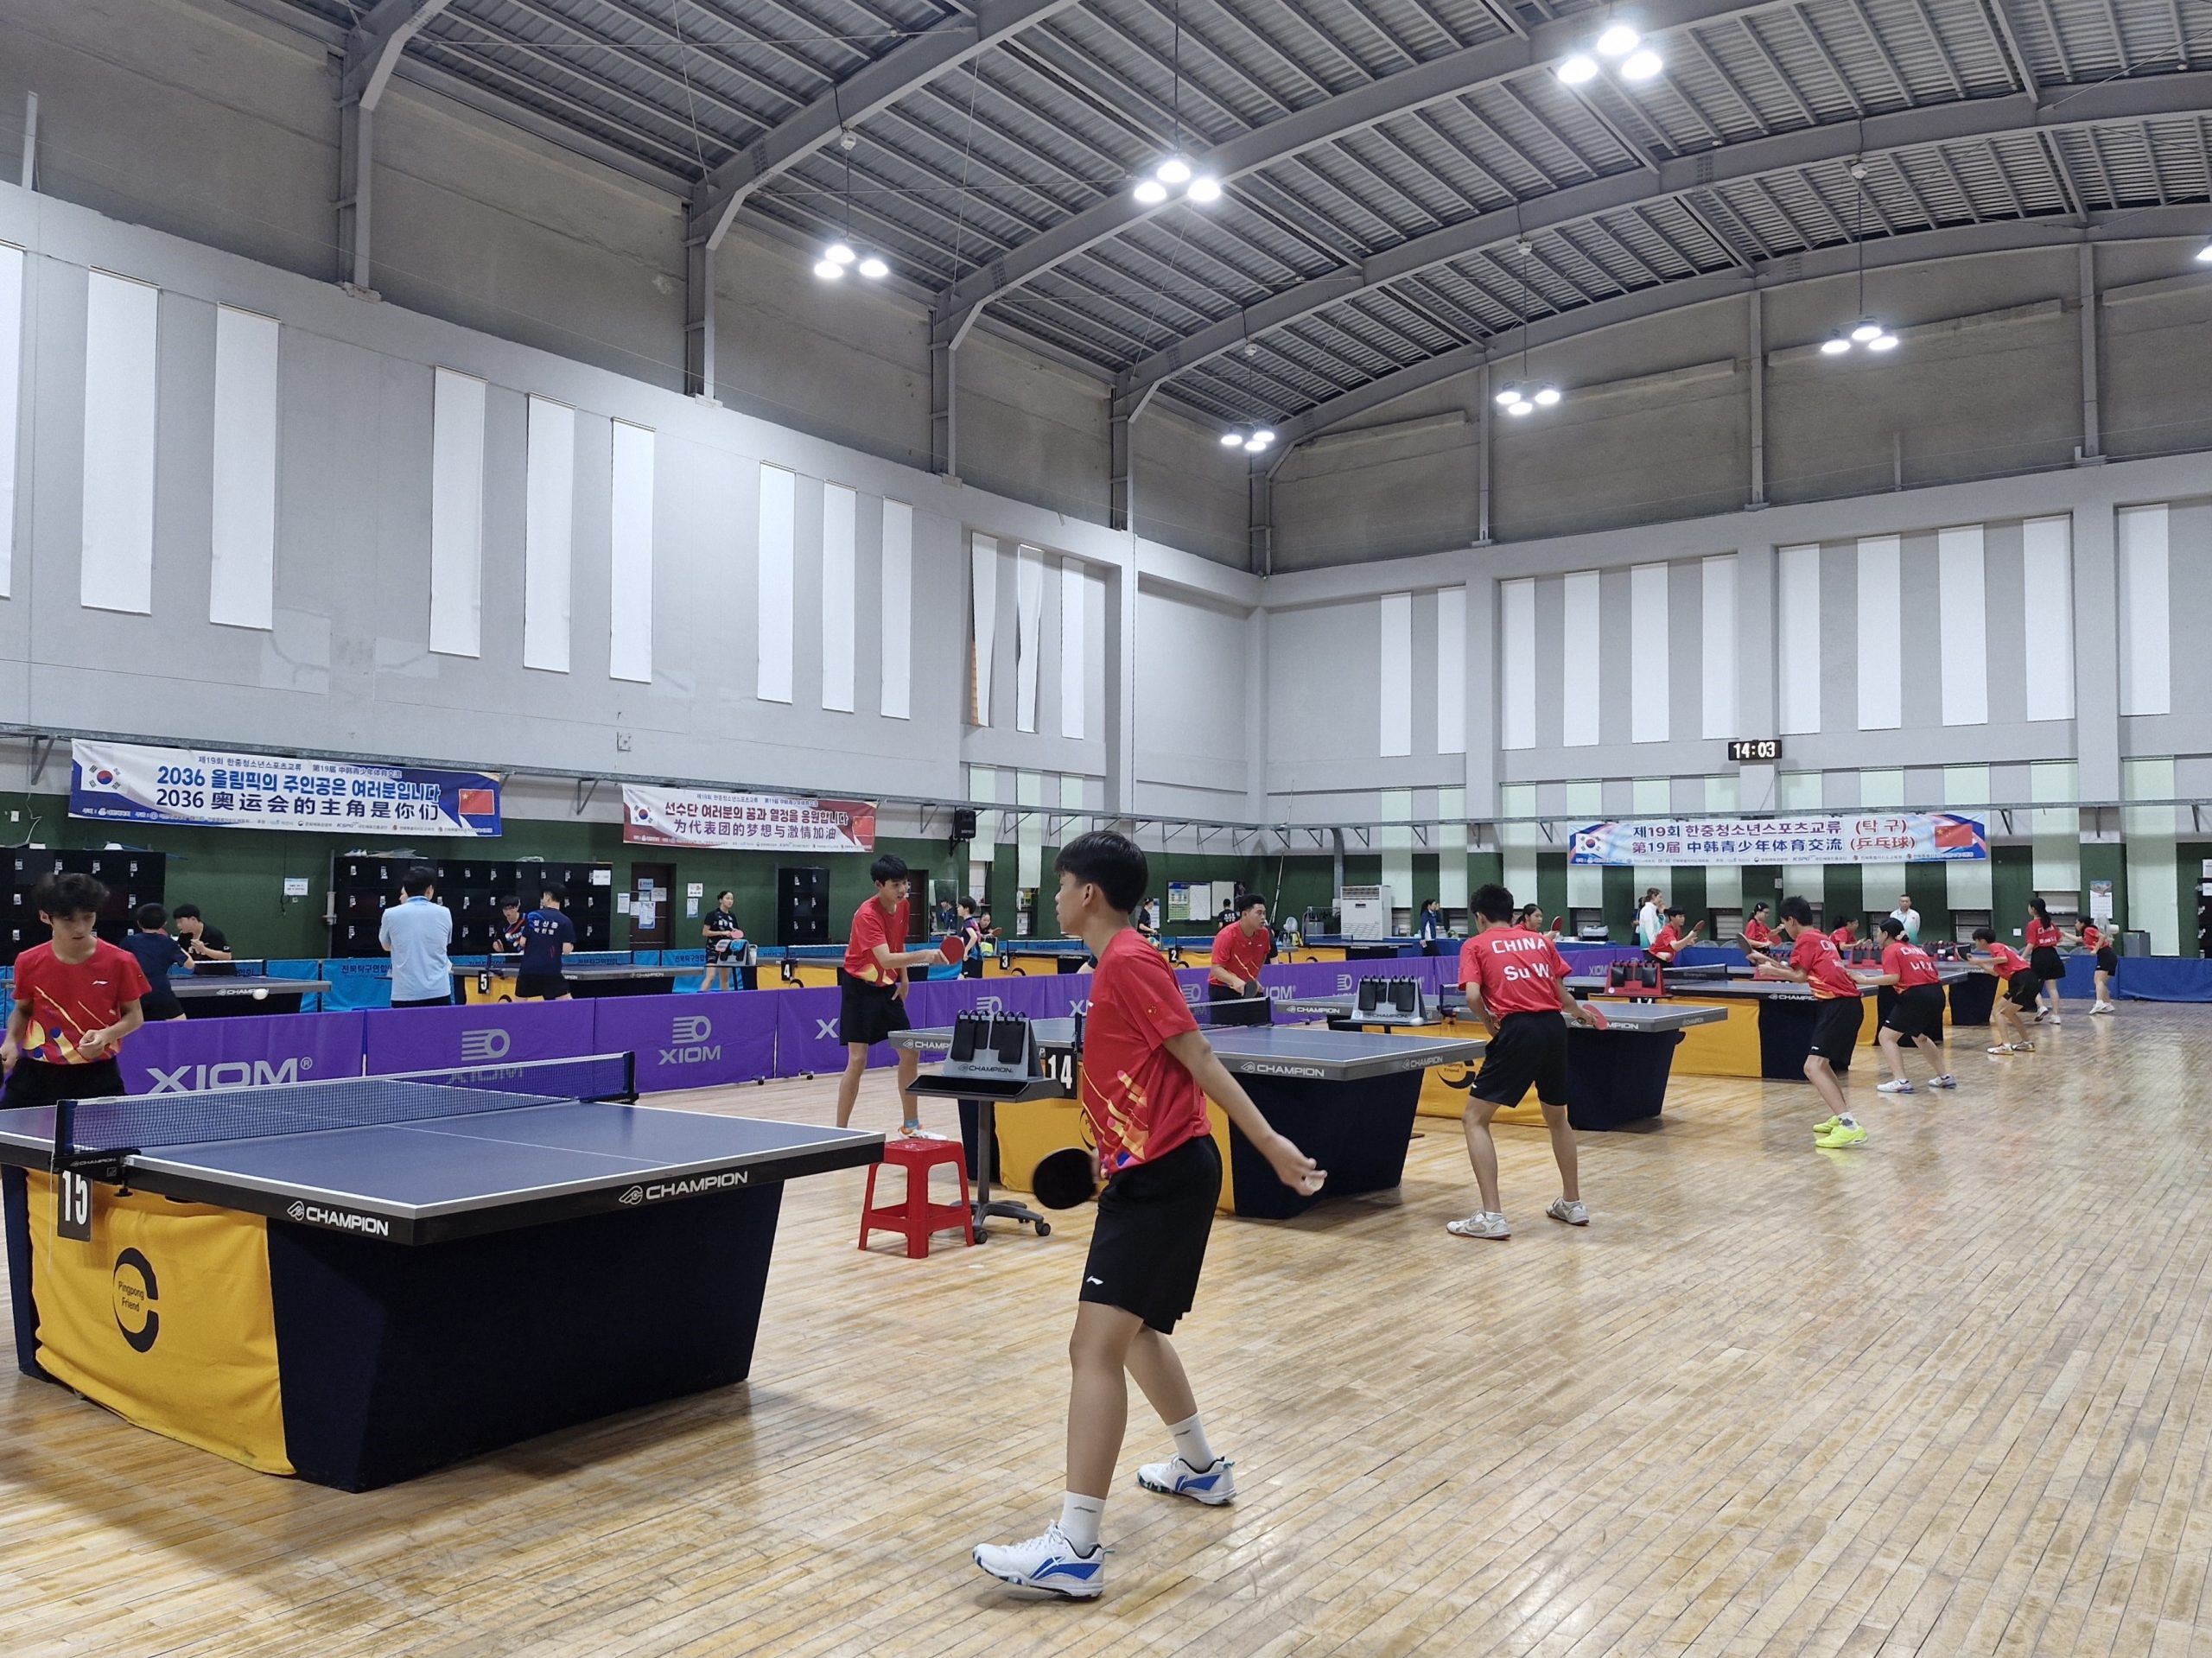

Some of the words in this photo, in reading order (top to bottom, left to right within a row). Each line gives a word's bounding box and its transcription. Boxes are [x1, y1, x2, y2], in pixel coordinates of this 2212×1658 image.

[1733, 741, 1775, 759] 14:03
[157, 765, 206, 787] 2036
[211, 769, 277, 792] 올림픽의
[283, 775, 346, 797] 주인공은
[352, 779, 442, 802] 여러분입니다
[156, 788, 204, 808] 2036
[211, 791, 439, 821] 奥运会的主角是你们
[664, 802, 698, 817] 선수단
[702, 804, 743, 820] 여러분의
[746, 807, 767, 821] 꿈과
[770, 809, 798, 823] 열정을
[801, 810, 848, 825] 응원합니다
[674, 818, 836, 840] 为代表团的梦想与激情加油
[1632, 825, 1681, 838] 제19회
[1685, 821, 1842, 838] 한중청소년스포츠교류
[1632, 842, 1681, 854] 第19届
[1491, 937, 1548, 954] CHINA
[1002, 956, 1008, 968] 3
[1171, 950, 1177, 961] 2
[341, 964, 392, 974] 전북탁구연합
[784, 964, 791, 977] 4
[1503, 965, 1531, 981] Su
[480, 974, 487, 990] 5
[914, 1041, 950, 1050] CHAMP
[658, 1045, 721, 1065] XIOM
[1410, 1055, 1444, 1068] CHAMPION
[969, 1064, 1012, 1074] CHAMPION
[1047, 1053, 1073, 1089] 14
[1256, 1064, 1325, 1077] CHAMPION
[645, 1170, 748, 1200] CHAMPION
[62, 1170, 88, 1225] 15
[306, 1206, 389, 1236] CHAMPION
[118, 1280, 145, 1301] Pingpong
[122, 1297, 140, 1312] Friend
